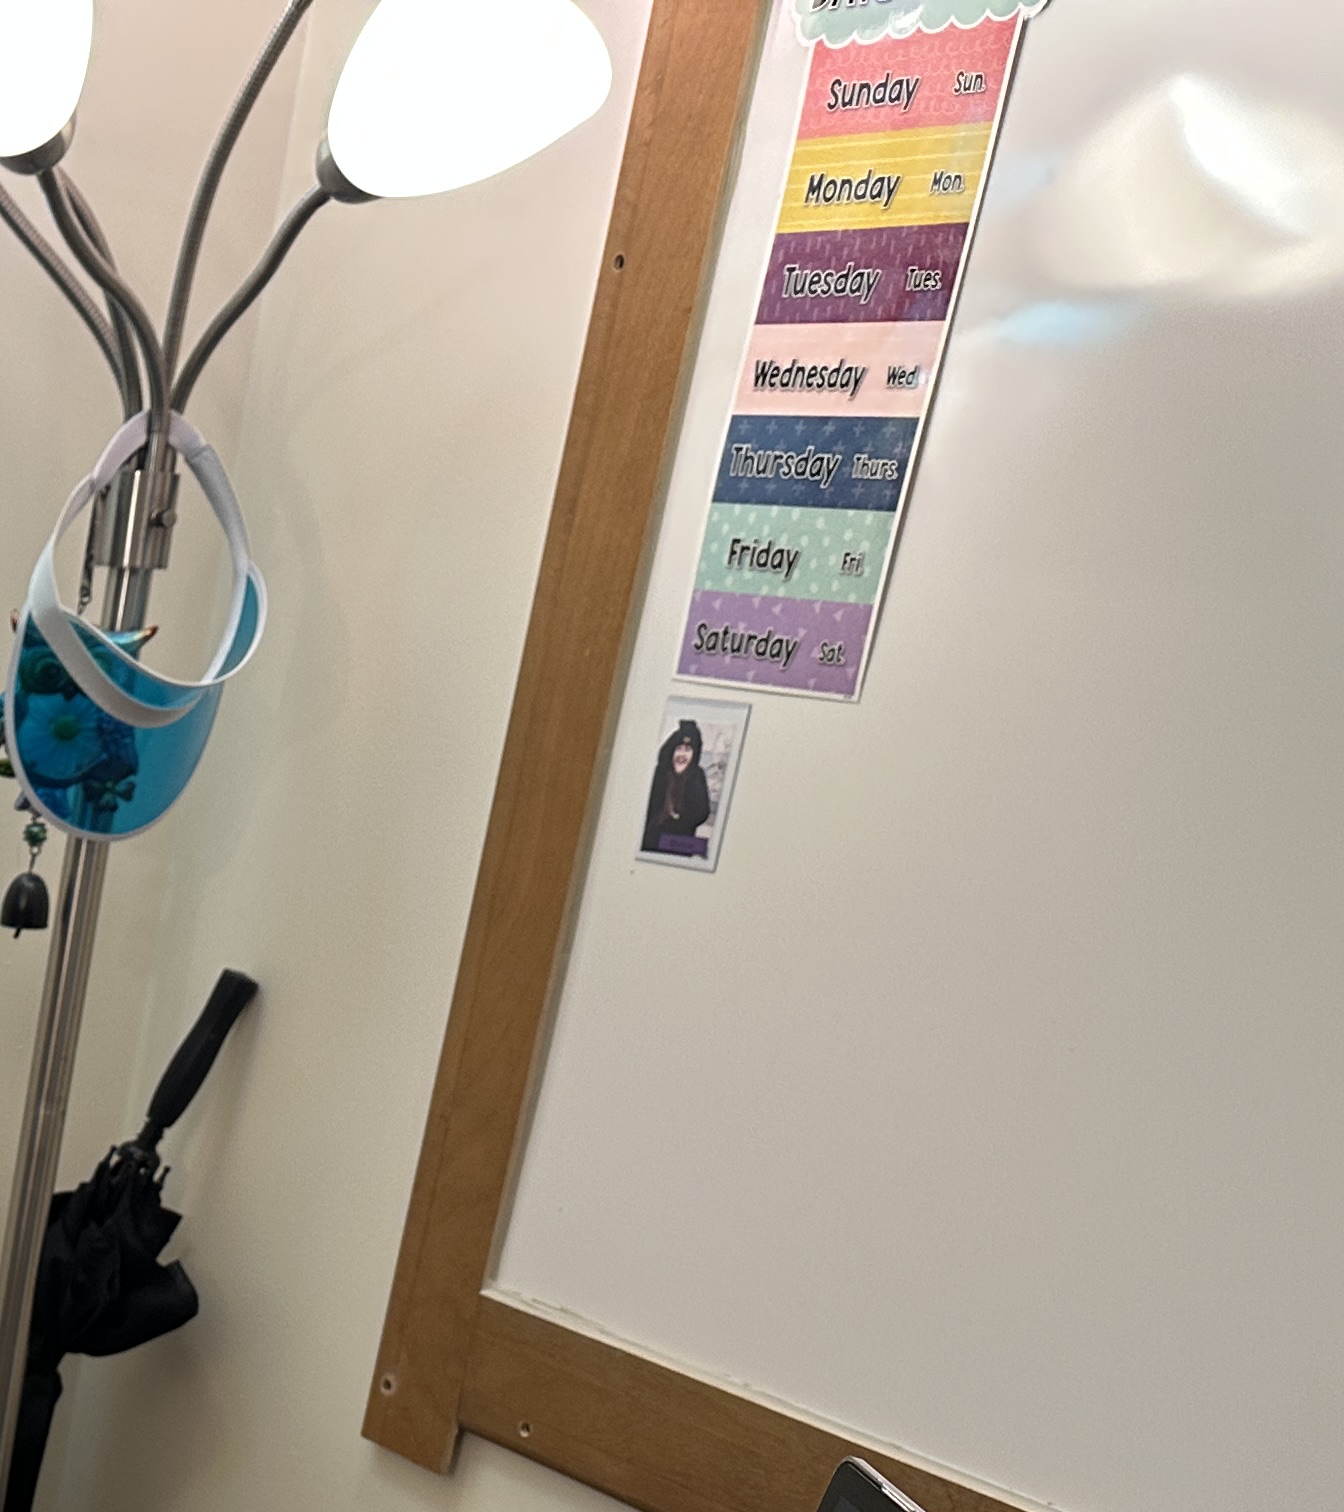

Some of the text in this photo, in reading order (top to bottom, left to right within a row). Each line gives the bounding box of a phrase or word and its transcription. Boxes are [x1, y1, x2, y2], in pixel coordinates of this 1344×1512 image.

[826, 72, 920, 110] Sunday
[803, 169, 900, 208] Monday
[783, 262, 880, 303] Tuesday
[753, 358, 867, 399] Wednesday
[730, 445, 840, 488] Thursday
[727, 538, 799, 579] Friday
[693, 622, 797, 668] Saturday
